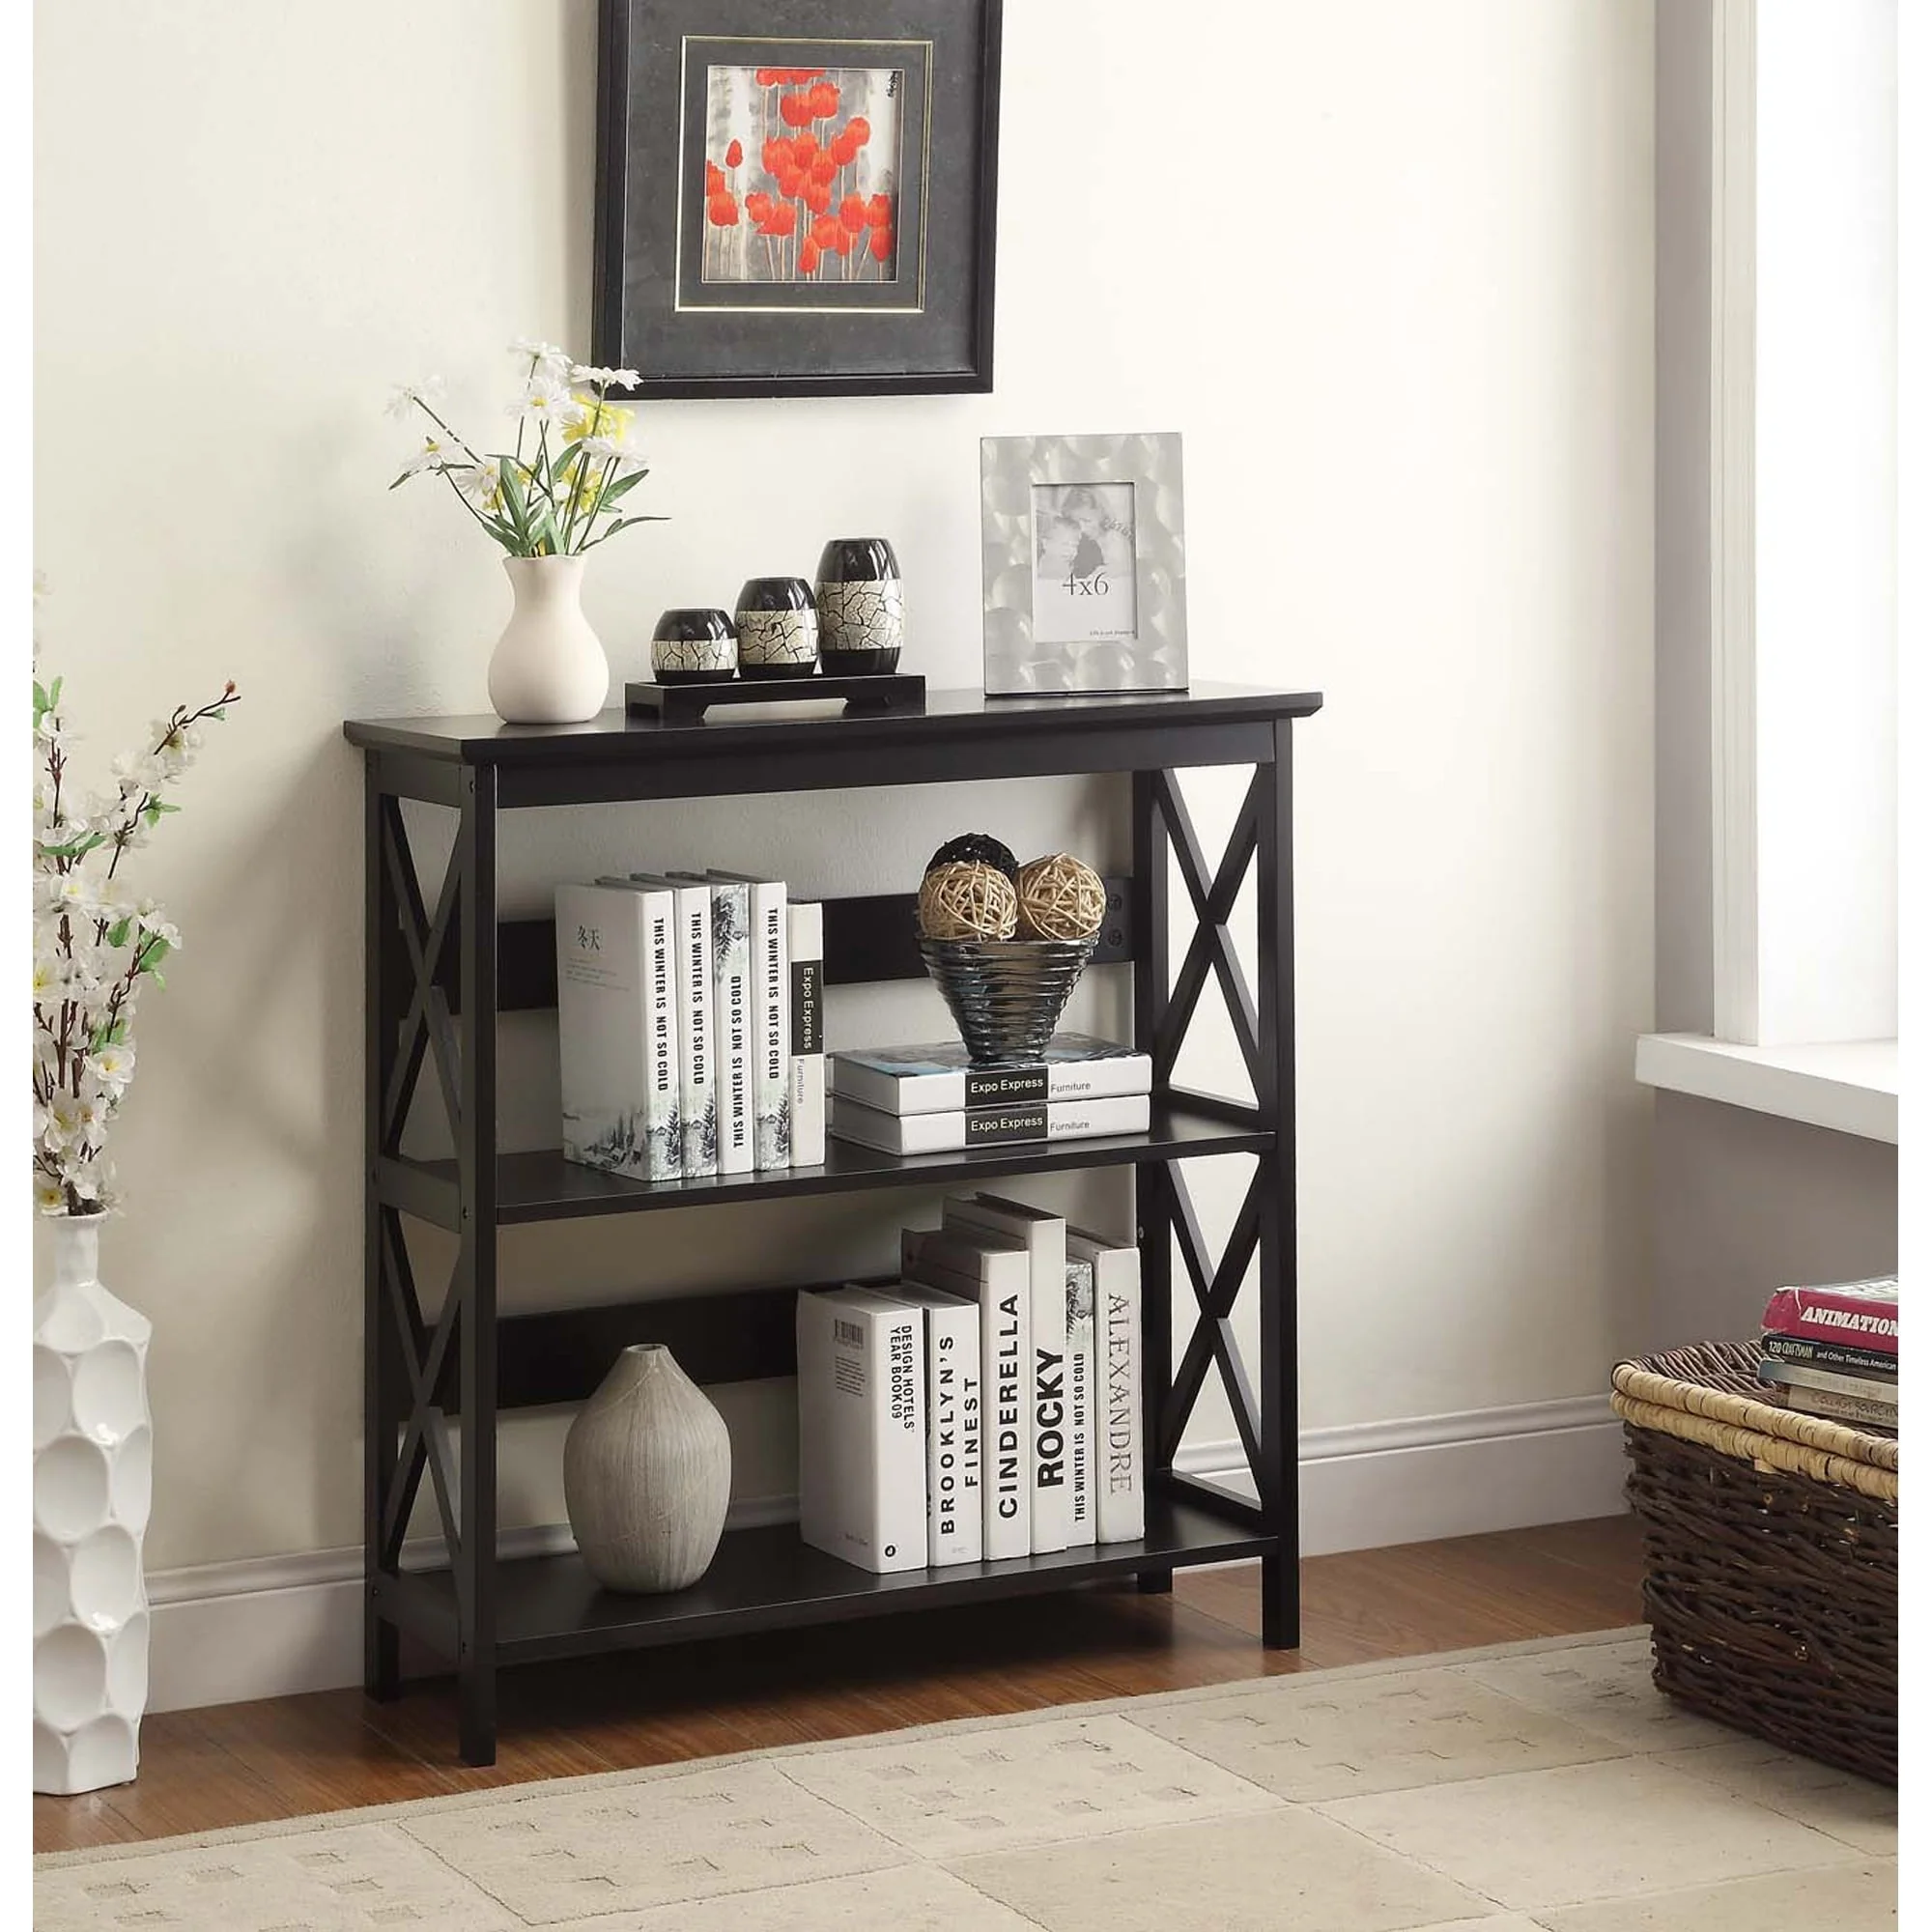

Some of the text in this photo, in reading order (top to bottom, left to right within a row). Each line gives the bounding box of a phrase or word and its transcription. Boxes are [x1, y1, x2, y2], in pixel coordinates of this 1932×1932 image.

[1062, 571, 1109, 596] 4x6
[653, 918, 668, 1091] THIS WINTER IS NOT SO COLD
[691, 912, 704, 1085] THIS WINTER IS NOT SO COLD
[768, 907, 780, 1079] THIS WINTER IS NOT SO COLD
[801, 967, 814, 1049] Expo Express
[730, 976, 744, 1148] THIS WINTER IS NOT SO COLD
[796, 1059, 805, 1104] Furniture
[970, 1077, 1044, 1094] Expo Express
[1050, 1081, 1092, 1093] Furniture
[970, 1116, 1043, 1133] Expo Express
[1049, 1121, 1091, 1132] Furniture
[890, 1326, 901, 1361] YEAR
[901, 1324, 914, 1374] DESIGN
[1801, 1306, 1898, 1337] ANIMATION
[1816, 1350, 1828, 1359] and
[1828, 1351, 1845, 1363] Other
[1845, 1354, 1869, 1367] Timeless
[1869, 1359, 1896, 1372] American
[940, 1336, 954, 1534] BROOKLYN'S
[964, 1378, 979, 1488] FINEST
[998, 1293, 1019, 1519] CINDERELLA
[1037, 1348, 1064, 1489] ROCKY
[1108, 1293, 1132, 1495] ALEXANDRE
[1073, 1352, 1086, 1523] THIS WINTER IS NOT SO COLD
